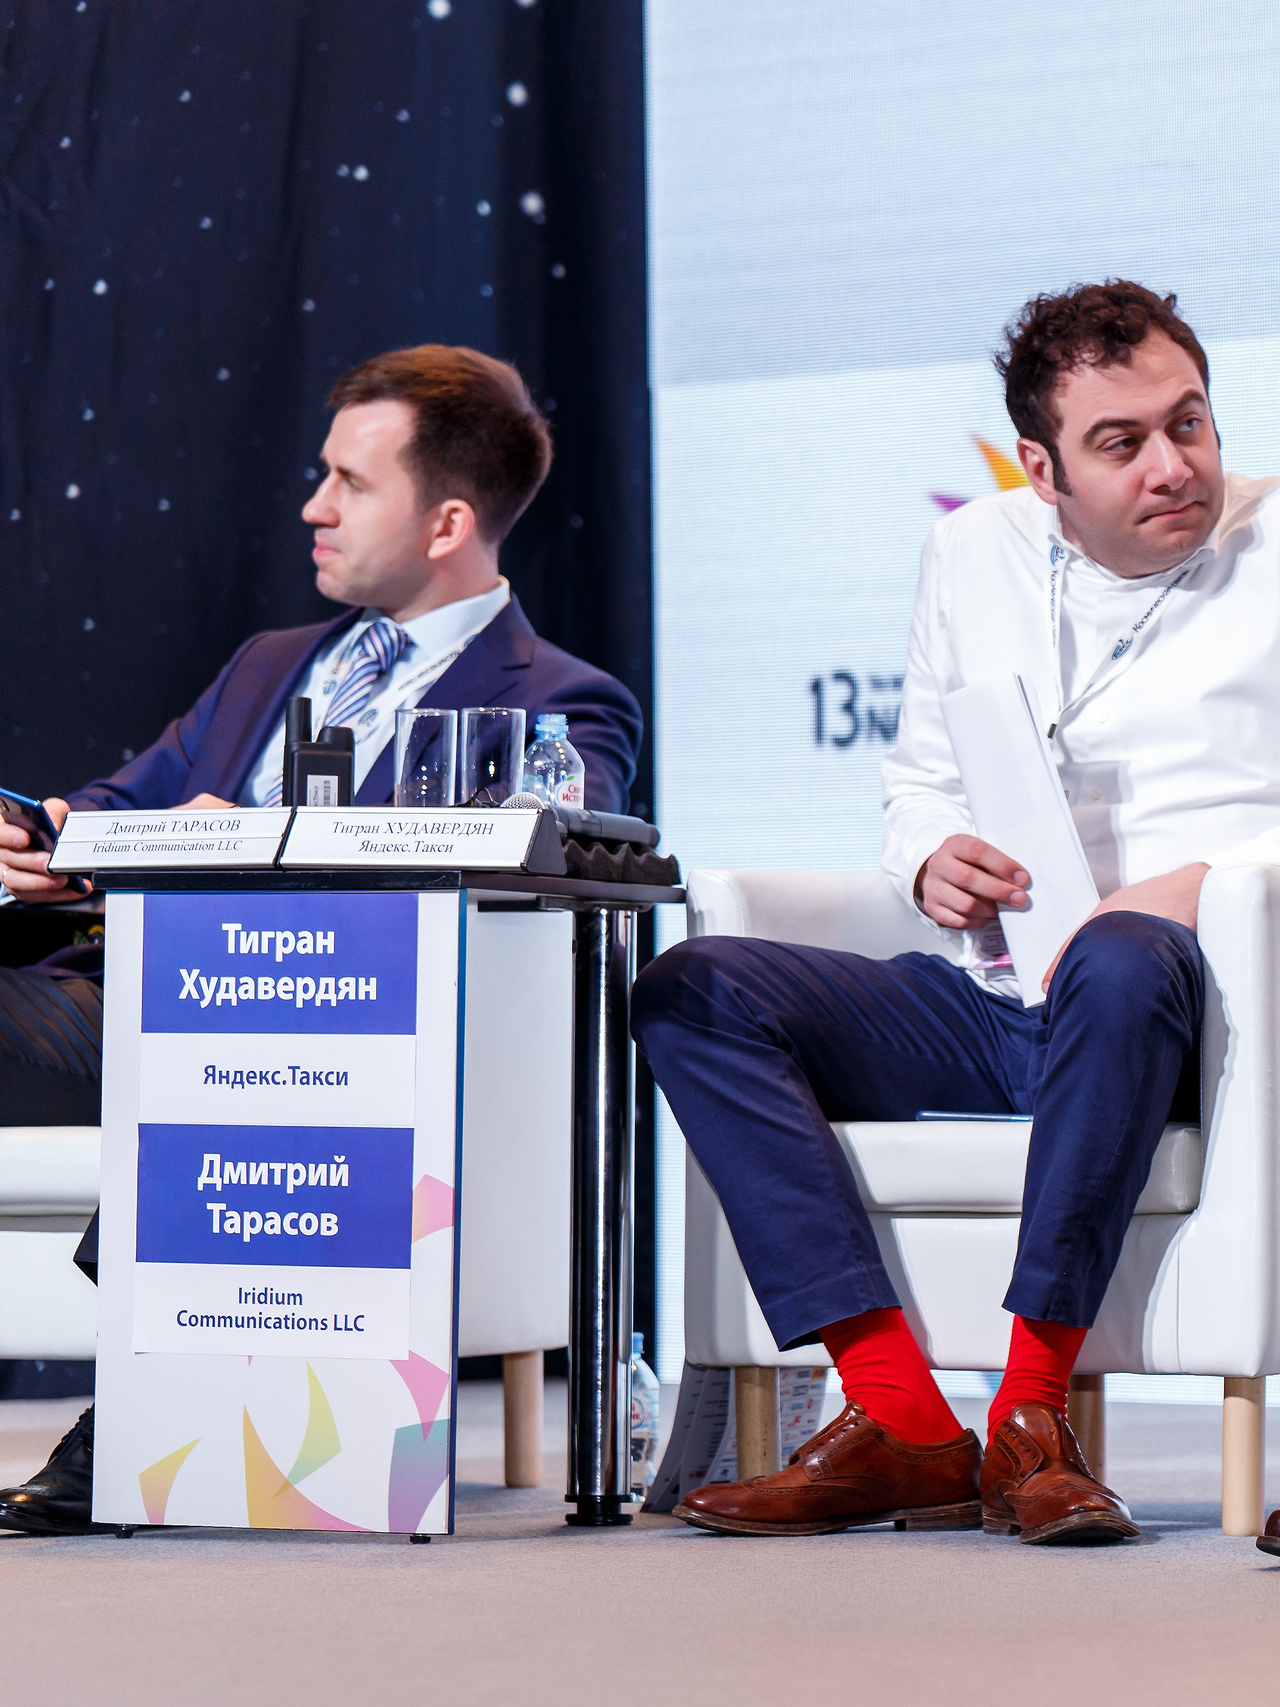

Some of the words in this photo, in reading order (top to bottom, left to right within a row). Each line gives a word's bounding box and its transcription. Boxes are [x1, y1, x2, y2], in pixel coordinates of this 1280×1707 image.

[809, 670, 859, 748] 13
[106, 820, 165, 836] Дмитрий
[170, 819, 241, 833] ТАРАСОВ
[332, 821, 380, 834] Тигран
[383, 821, 495, 836] ХУДАВЕРДЯН
[92, 842, 131, 853] Iridium
[133, 841, 214, 852] Communication
[217, 840, 243, 851] LLC
[358, 840, 454, 854] Яндекс.Такси
[222, 923, 335, 962] Тигран
[179, 969, 377, 1009] Худавердян
[204, 1065, 348, 1089] Яндекс.Такси
[198, 1153, 349, 1194] Дмитрий
[207, 1203, 339, 1243] Тарасов
[239, 1287, 302, 1305] Iridium
[177, 1310, 328, 1330] Communications
[334, 1314, 364, 1332] LLC
